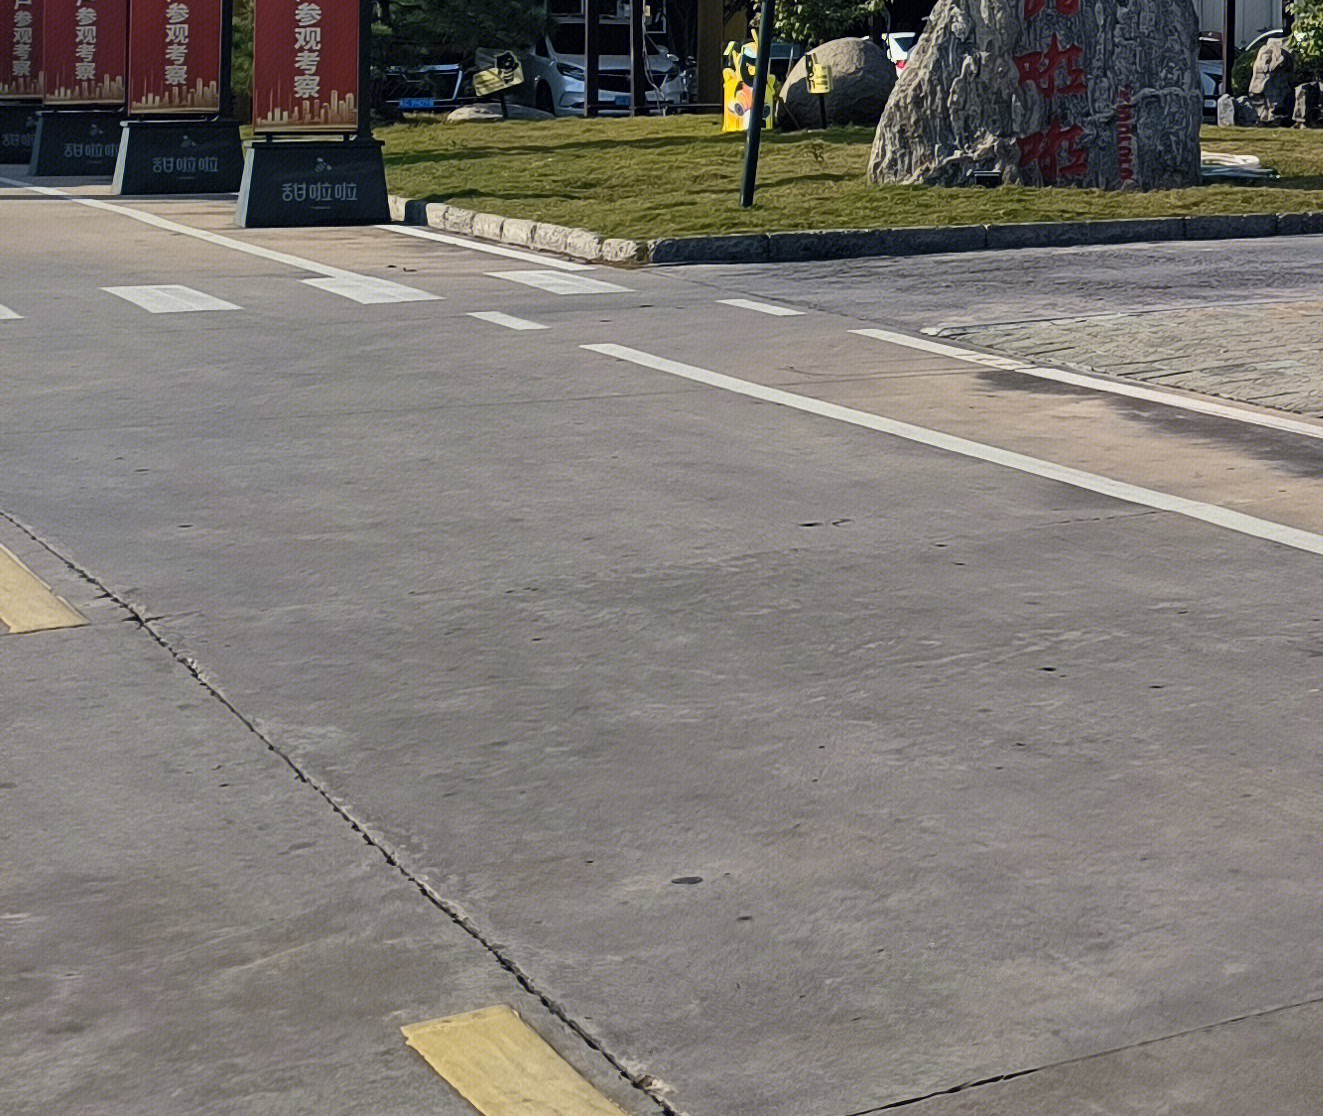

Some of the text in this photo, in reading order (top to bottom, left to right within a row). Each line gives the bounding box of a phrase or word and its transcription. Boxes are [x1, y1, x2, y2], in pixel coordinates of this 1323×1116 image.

[2, 134, 34, 147] 甜啦
[152, 156, 219, 174] 甜啦啦
[281, 181, 358, 203] 甜啦啦
